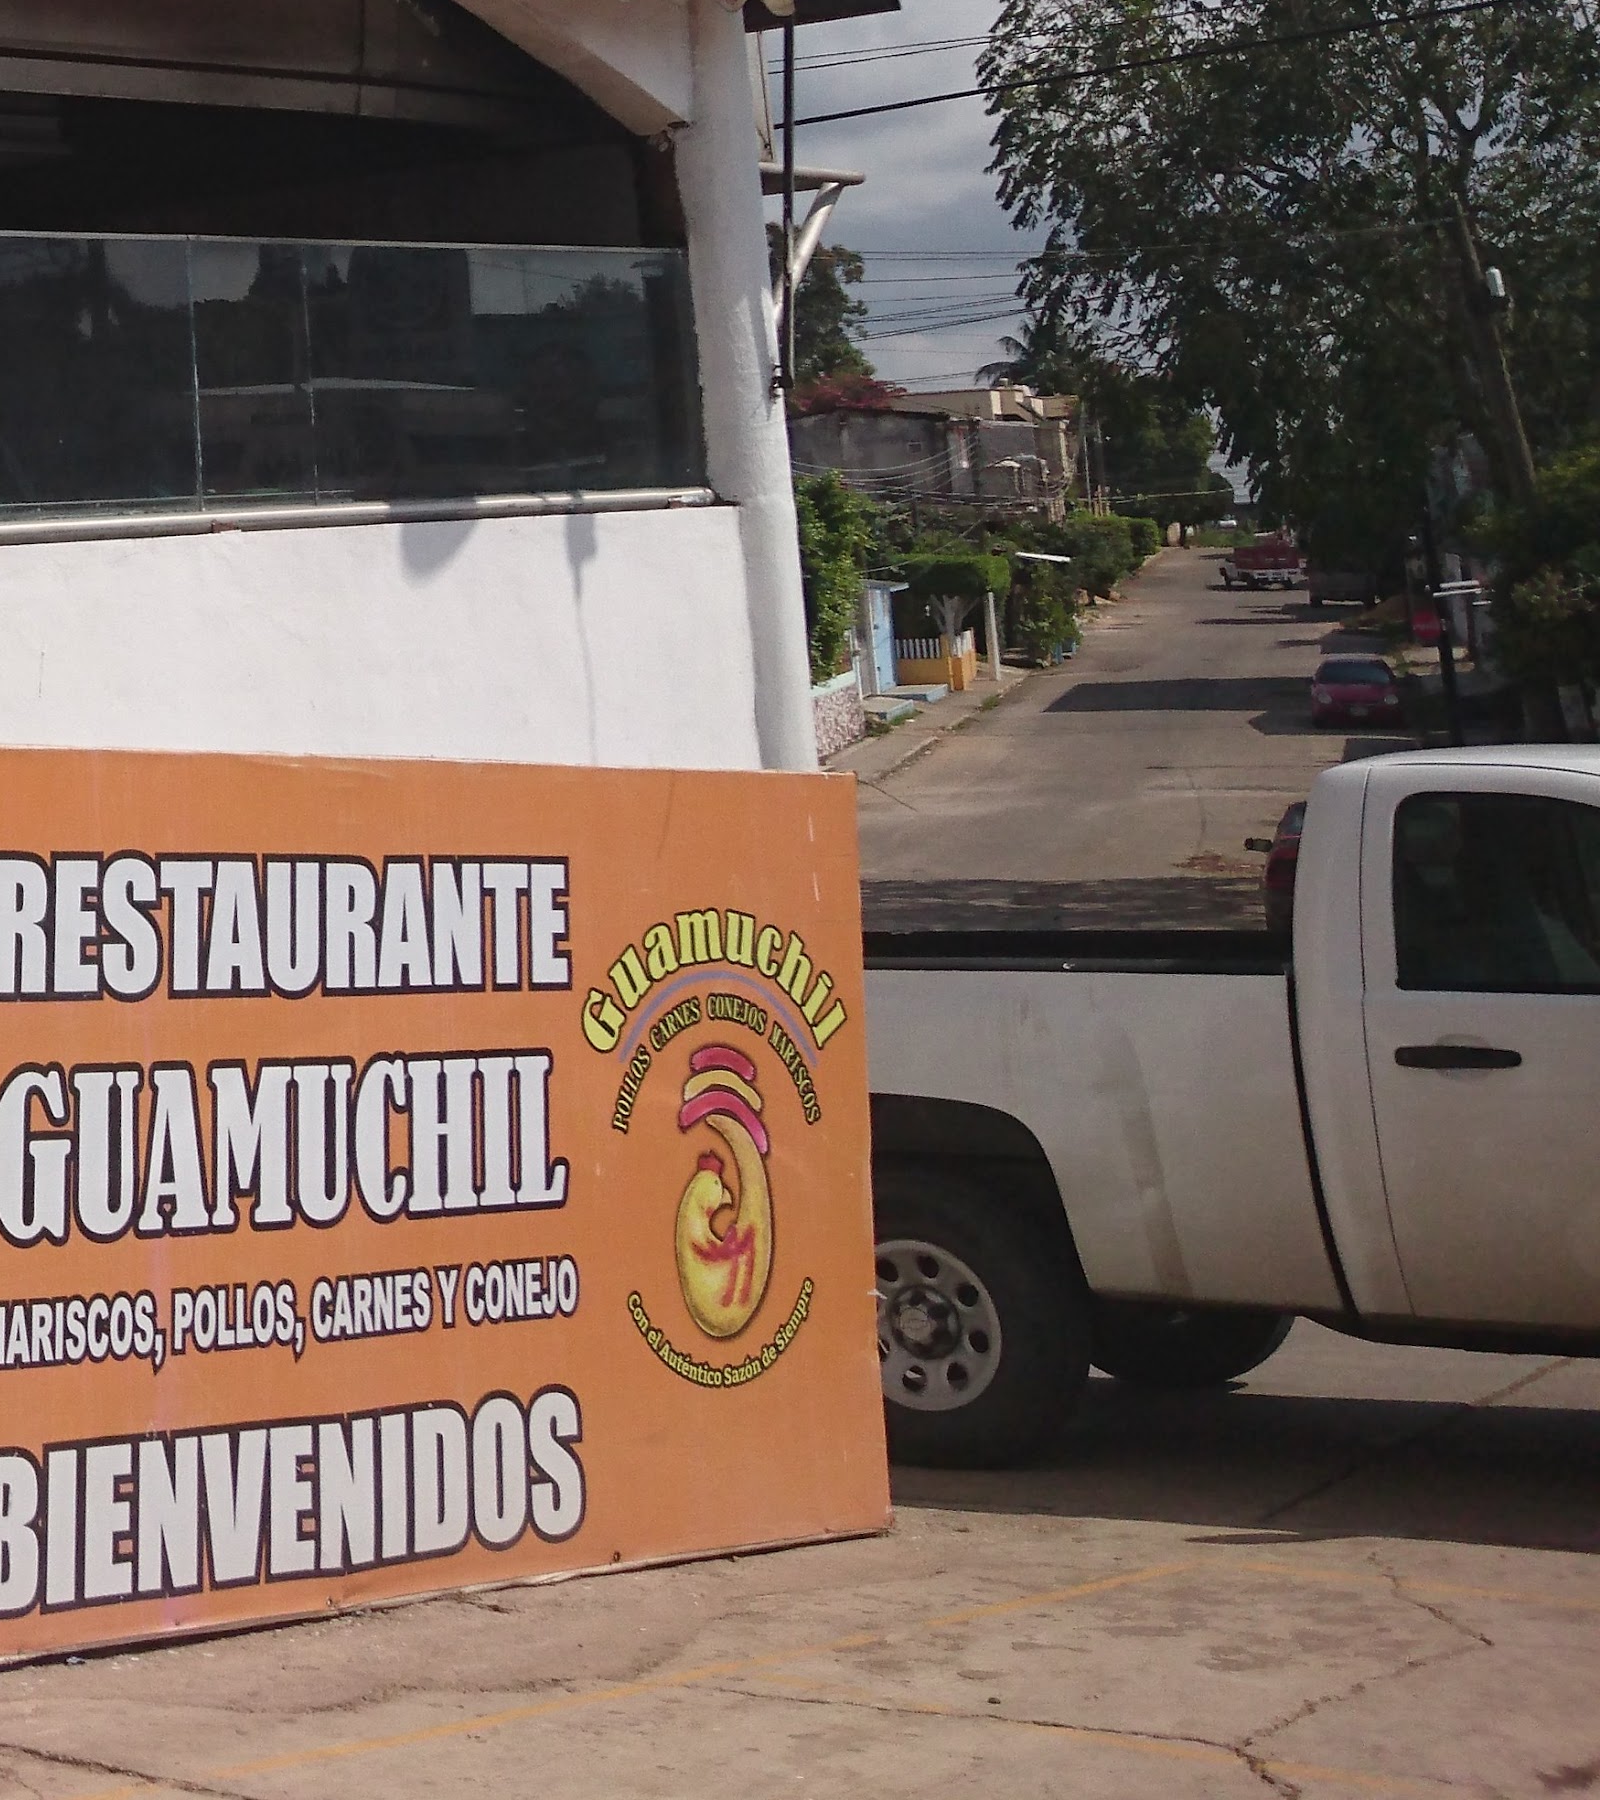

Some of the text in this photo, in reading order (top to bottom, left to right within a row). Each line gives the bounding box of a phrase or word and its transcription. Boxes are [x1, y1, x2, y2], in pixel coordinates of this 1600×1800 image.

[581, 908, 847, 1053] Guamuchil
[611, 993, 821, 1135] POLLOS CARNES CONEJOS MARISCOS
[171, 1279, 305, 1362] POLLOS,
[309, 1267, 432, 1342] CARNES
[434, 1263, 463, 1329] Y
[463, 1254, 580, 1326] CONEJO
[627, 1277, 814, 1388] Con el Auténtico Sazón de Siempre
